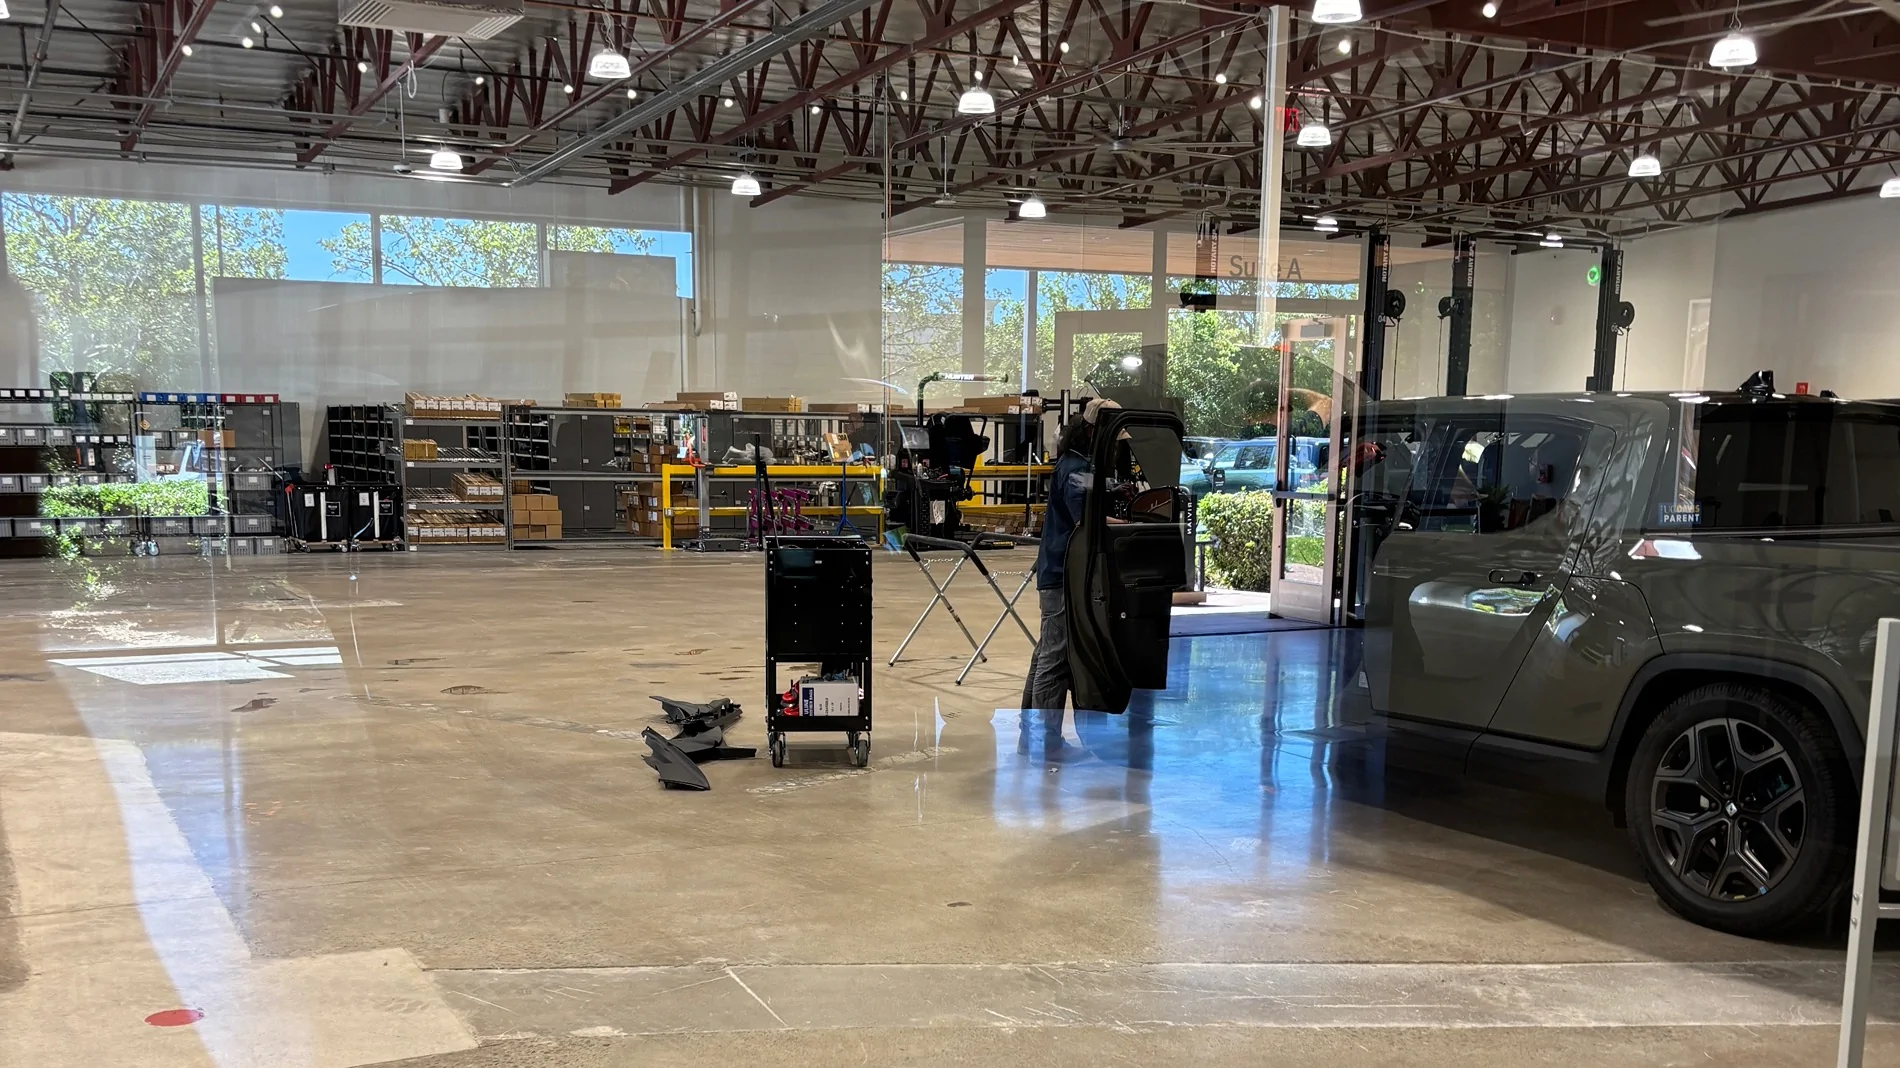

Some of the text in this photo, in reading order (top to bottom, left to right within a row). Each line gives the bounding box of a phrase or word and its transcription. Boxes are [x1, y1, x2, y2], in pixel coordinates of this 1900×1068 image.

[1210, 241, 1218, 274] ROTARY
[1229, 255, 1302, 280] Sue A
[1381, 252, 1389, 283] ROTARY
[944, 373, 975, 381] HUNTER
[1664, 514, 1700, 523] PARENT
